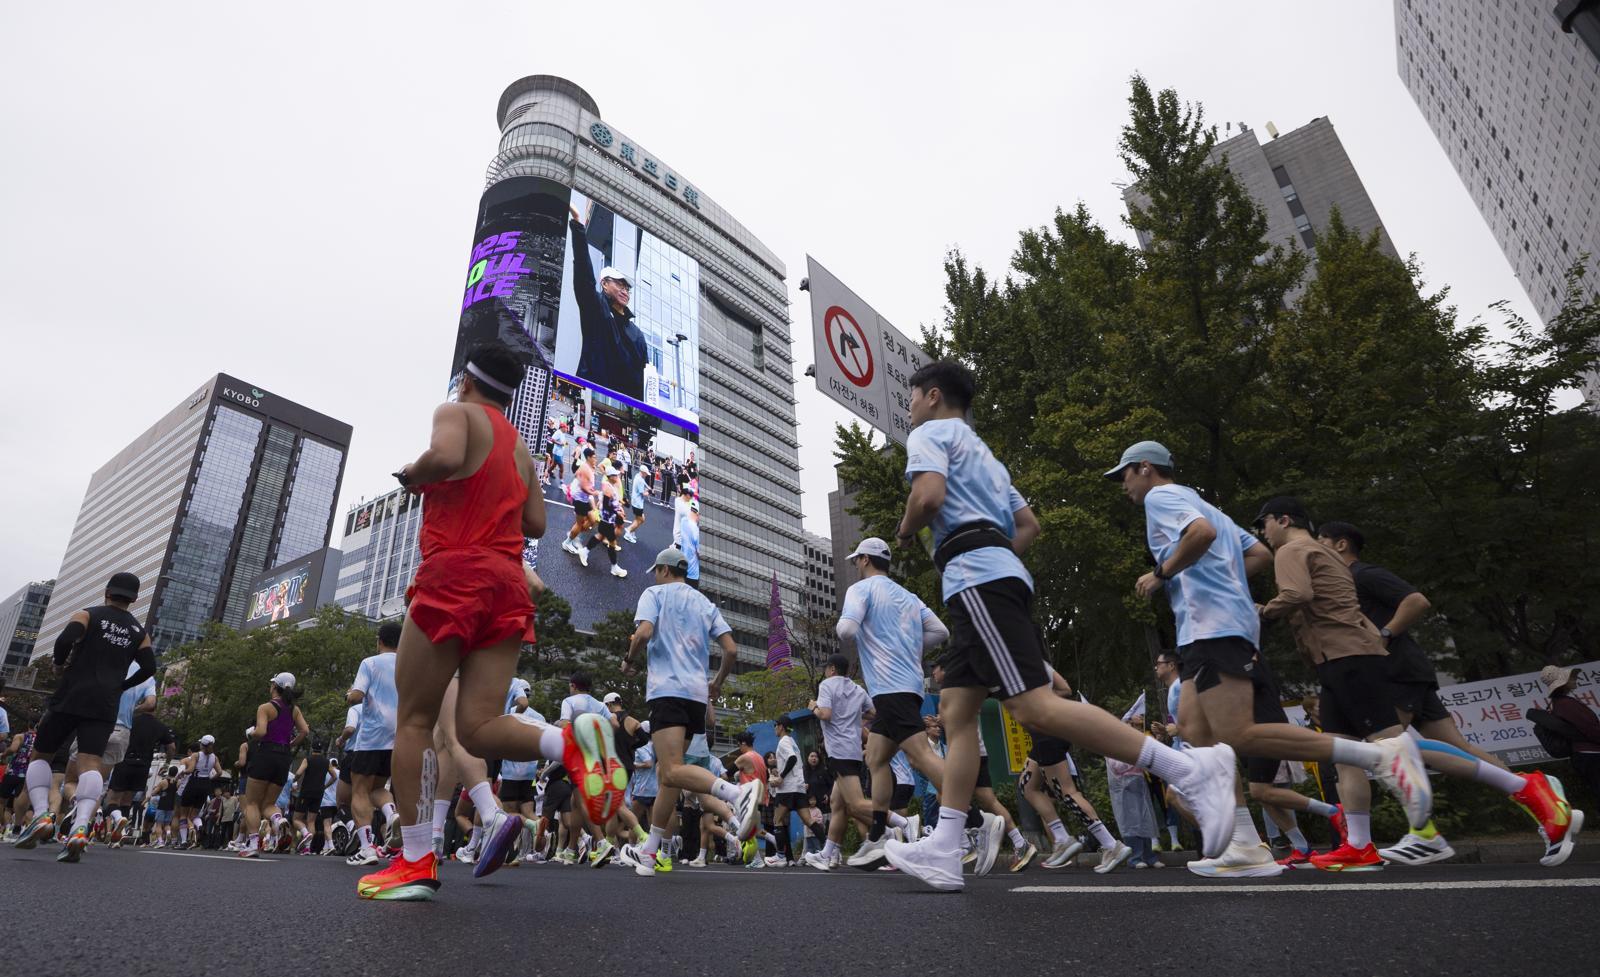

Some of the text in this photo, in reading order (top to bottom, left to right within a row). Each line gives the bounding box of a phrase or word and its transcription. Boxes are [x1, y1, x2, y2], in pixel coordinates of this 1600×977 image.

[467, 253, 532, 288] OUL
[223, 387, 260, 408] KYOBO
[829, 376, 879, 420] (자전거 허용)
[1507, 679, 1543, 698] 철거
[1481, 702, 1523, 723] 서울
